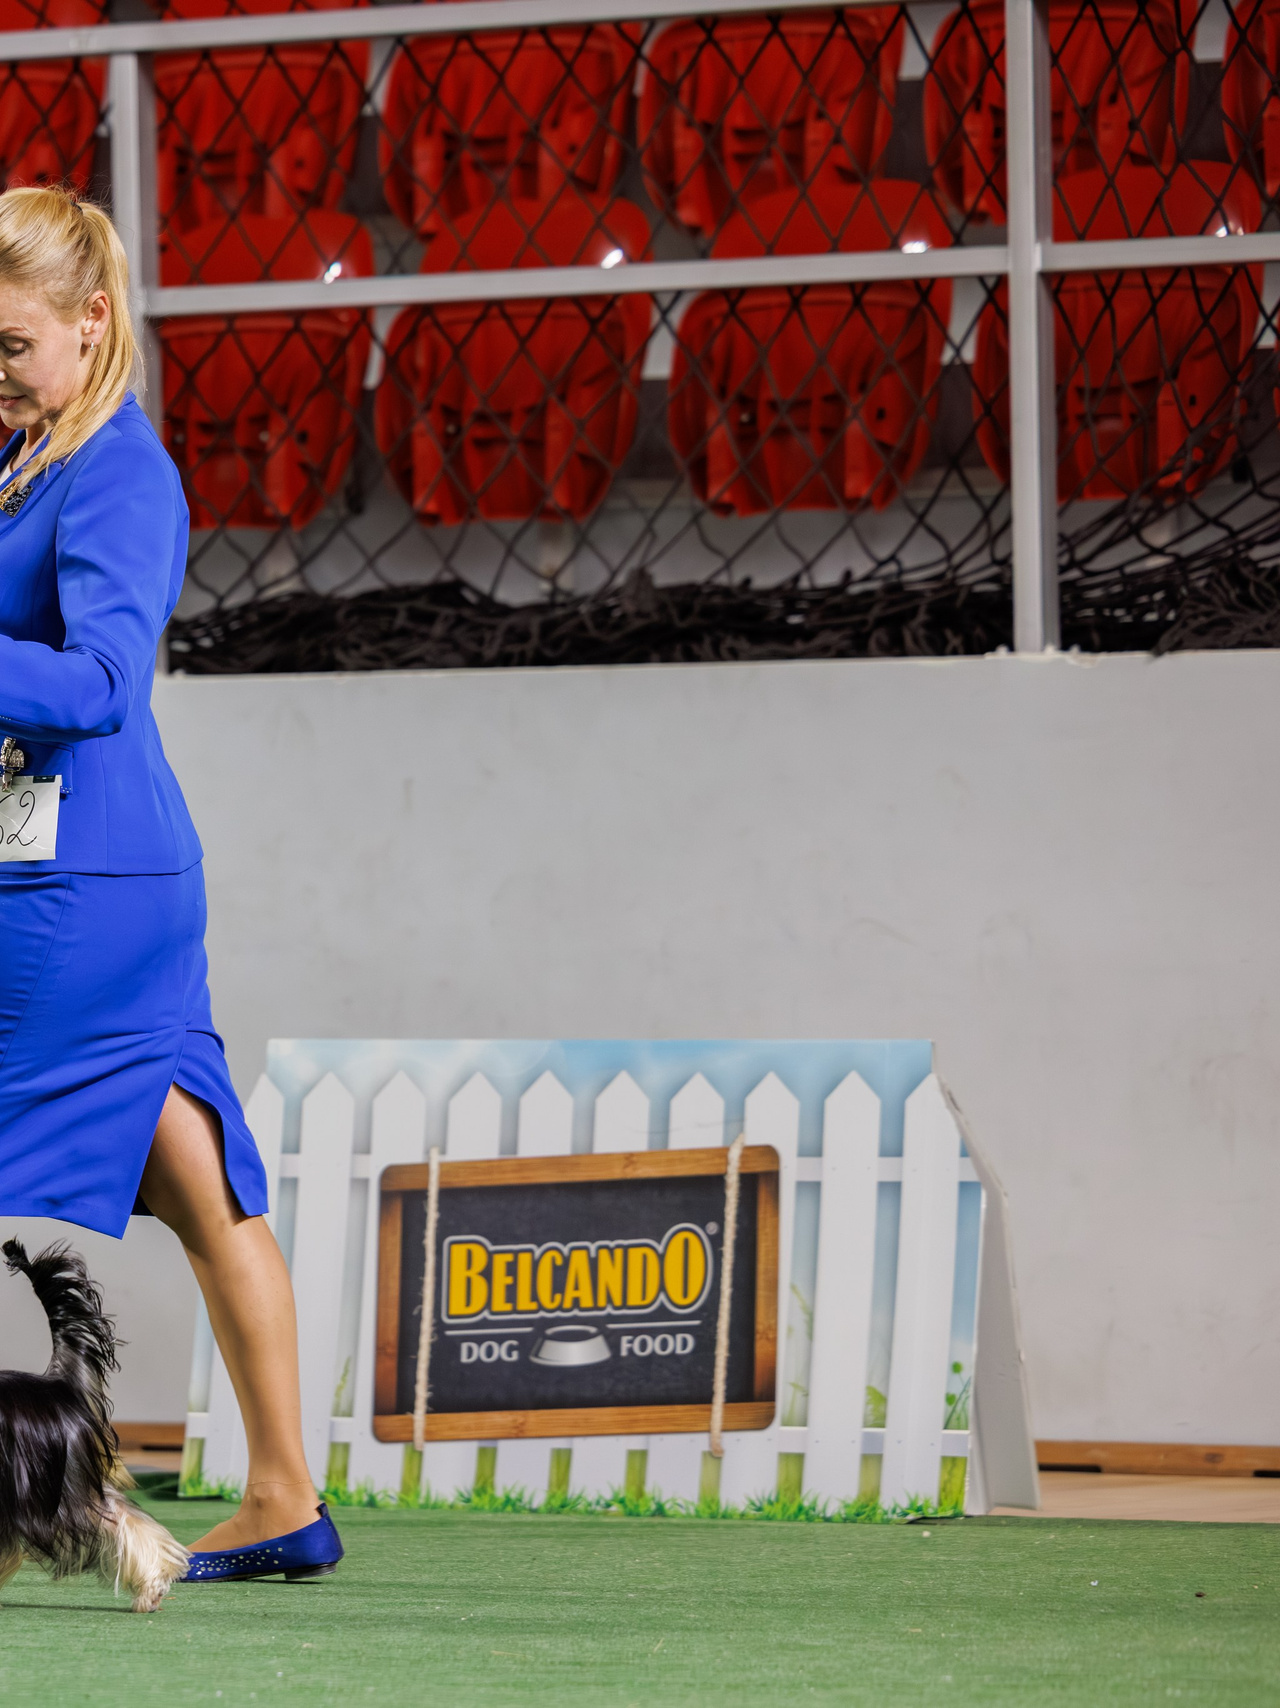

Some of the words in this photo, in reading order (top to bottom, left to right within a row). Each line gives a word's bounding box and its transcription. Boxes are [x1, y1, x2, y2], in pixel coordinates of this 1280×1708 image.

[445, 1228, 708, 1317] BELCANDO
[460, 1340, 519, 1364] DOG
[620, 1333, 695, 1357] FOOD
